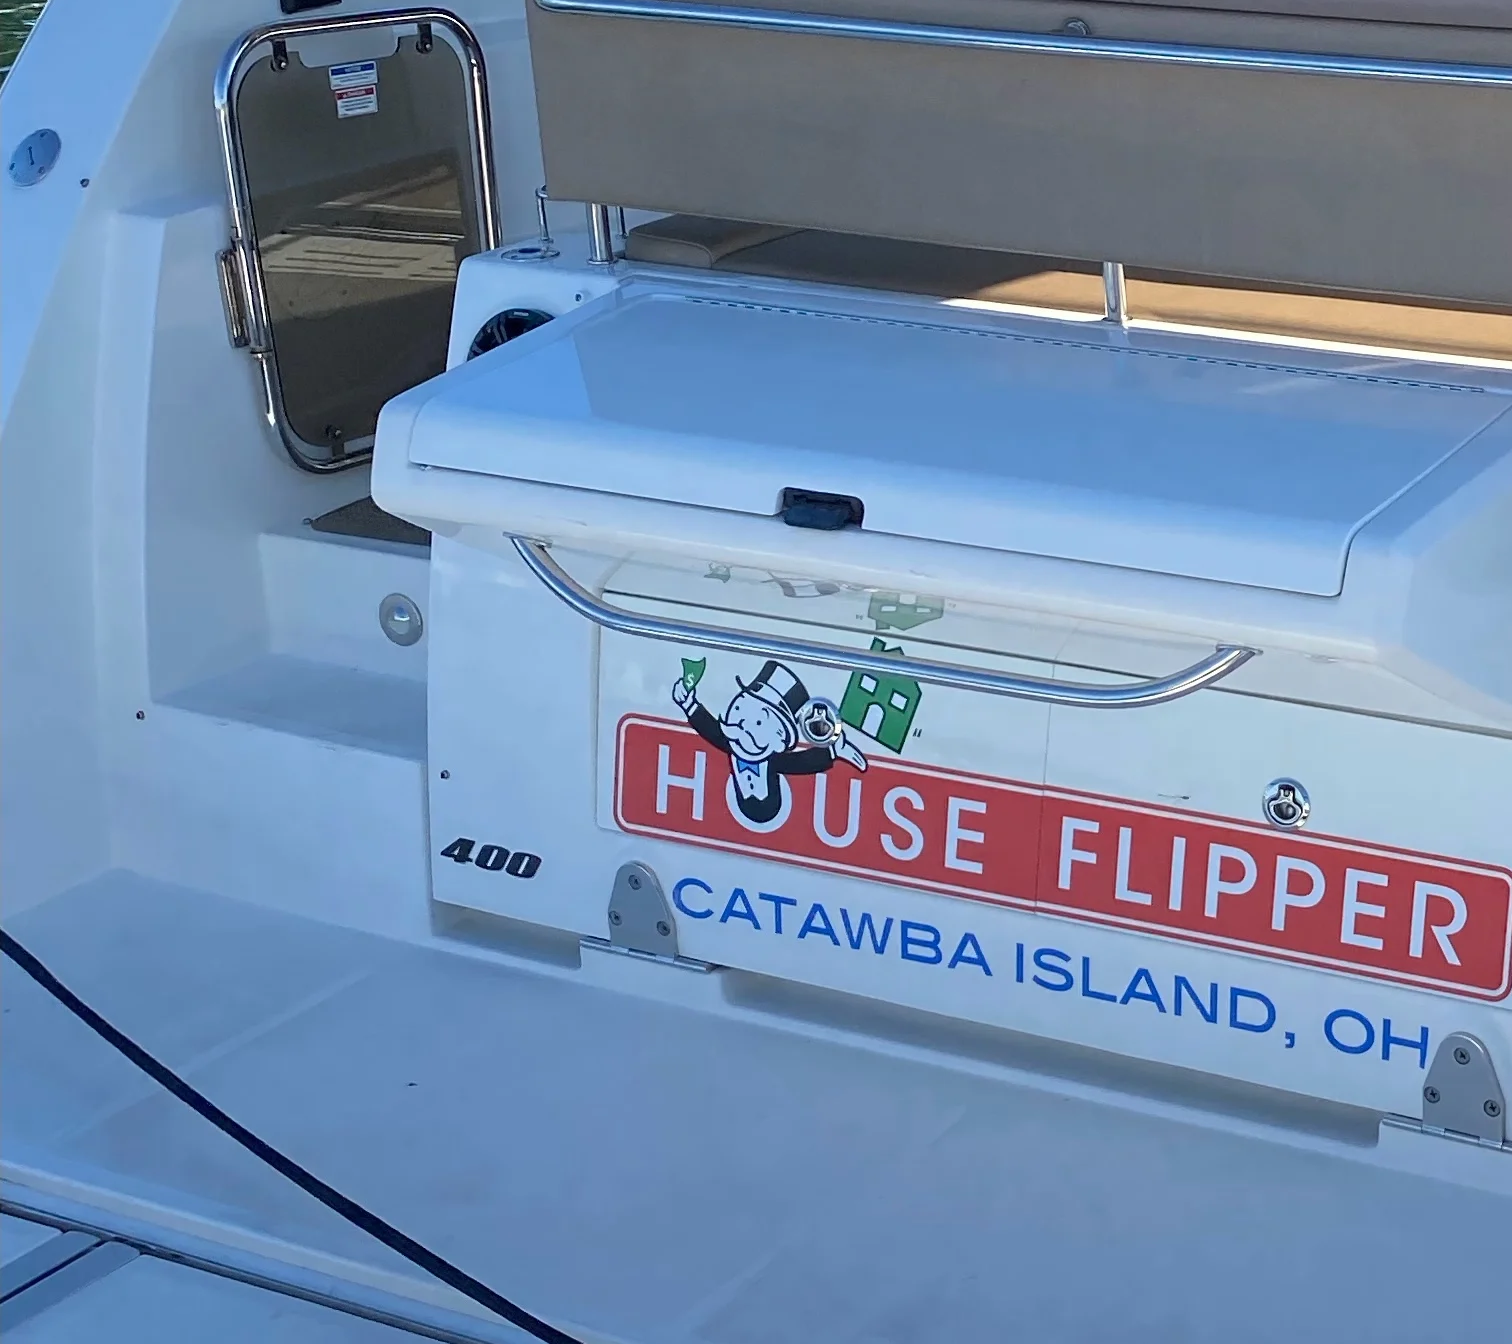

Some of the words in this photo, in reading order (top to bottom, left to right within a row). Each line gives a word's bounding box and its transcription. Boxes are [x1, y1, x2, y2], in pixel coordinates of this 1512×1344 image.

[440, 837, 542, 879] 400
[656, 744, 988, 875] HOUSE
[1057, 815, 1468, 967] FLIPPER
[672, 877, 993, 977] CATAWBA
[1015, 942, 1296, 1049] ISLAND,
[1323, 1008, 1430, 1069] OH
